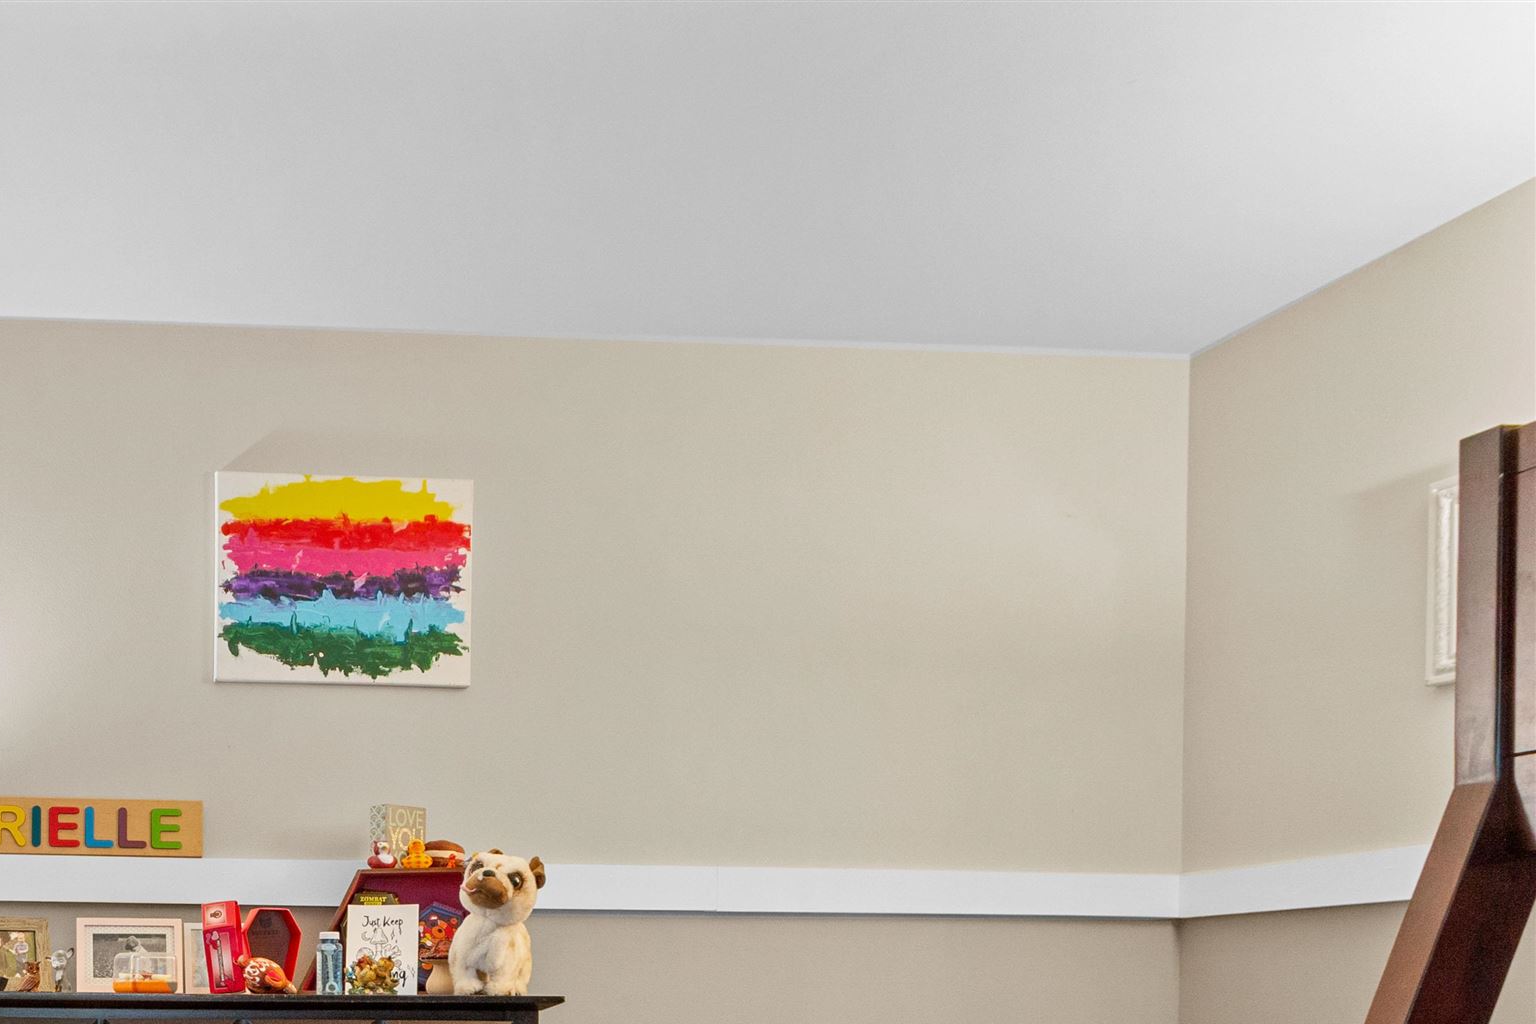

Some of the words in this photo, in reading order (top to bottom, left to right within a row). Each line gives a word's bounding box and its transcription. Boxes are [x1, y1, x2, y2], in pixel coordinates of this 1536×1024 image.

[389, 807, 424, 829] LOVE
[362, 915, 380, 927] Just
[383, 915, 404, 935] Keep
